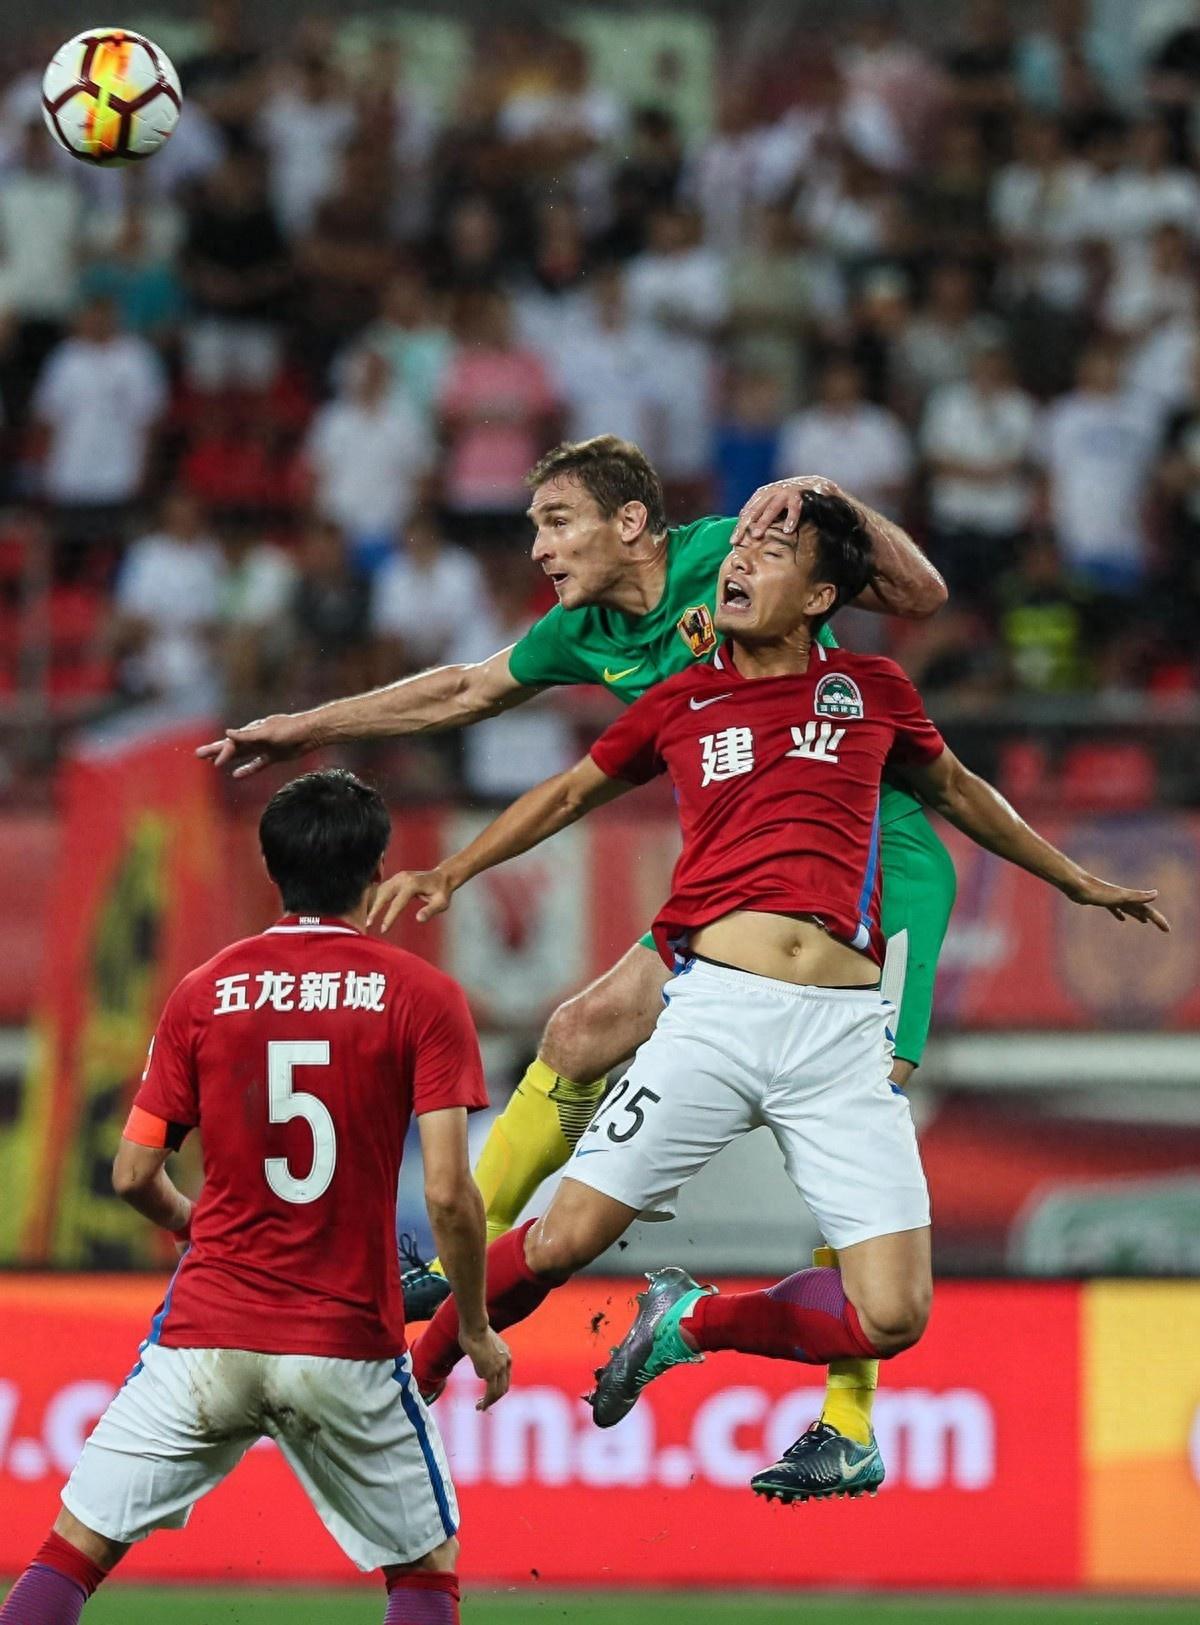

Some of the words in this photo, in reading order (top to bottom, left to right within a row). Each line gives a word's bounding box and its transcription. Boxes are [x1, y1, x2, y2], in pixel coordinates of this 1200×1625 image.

[699, 721, 846, 788] 建业
[213, 970, 386, 1016] 五龙新城
[264, 1040, 336, 1204] 5
[587, 1079, 662, 1143] 25
